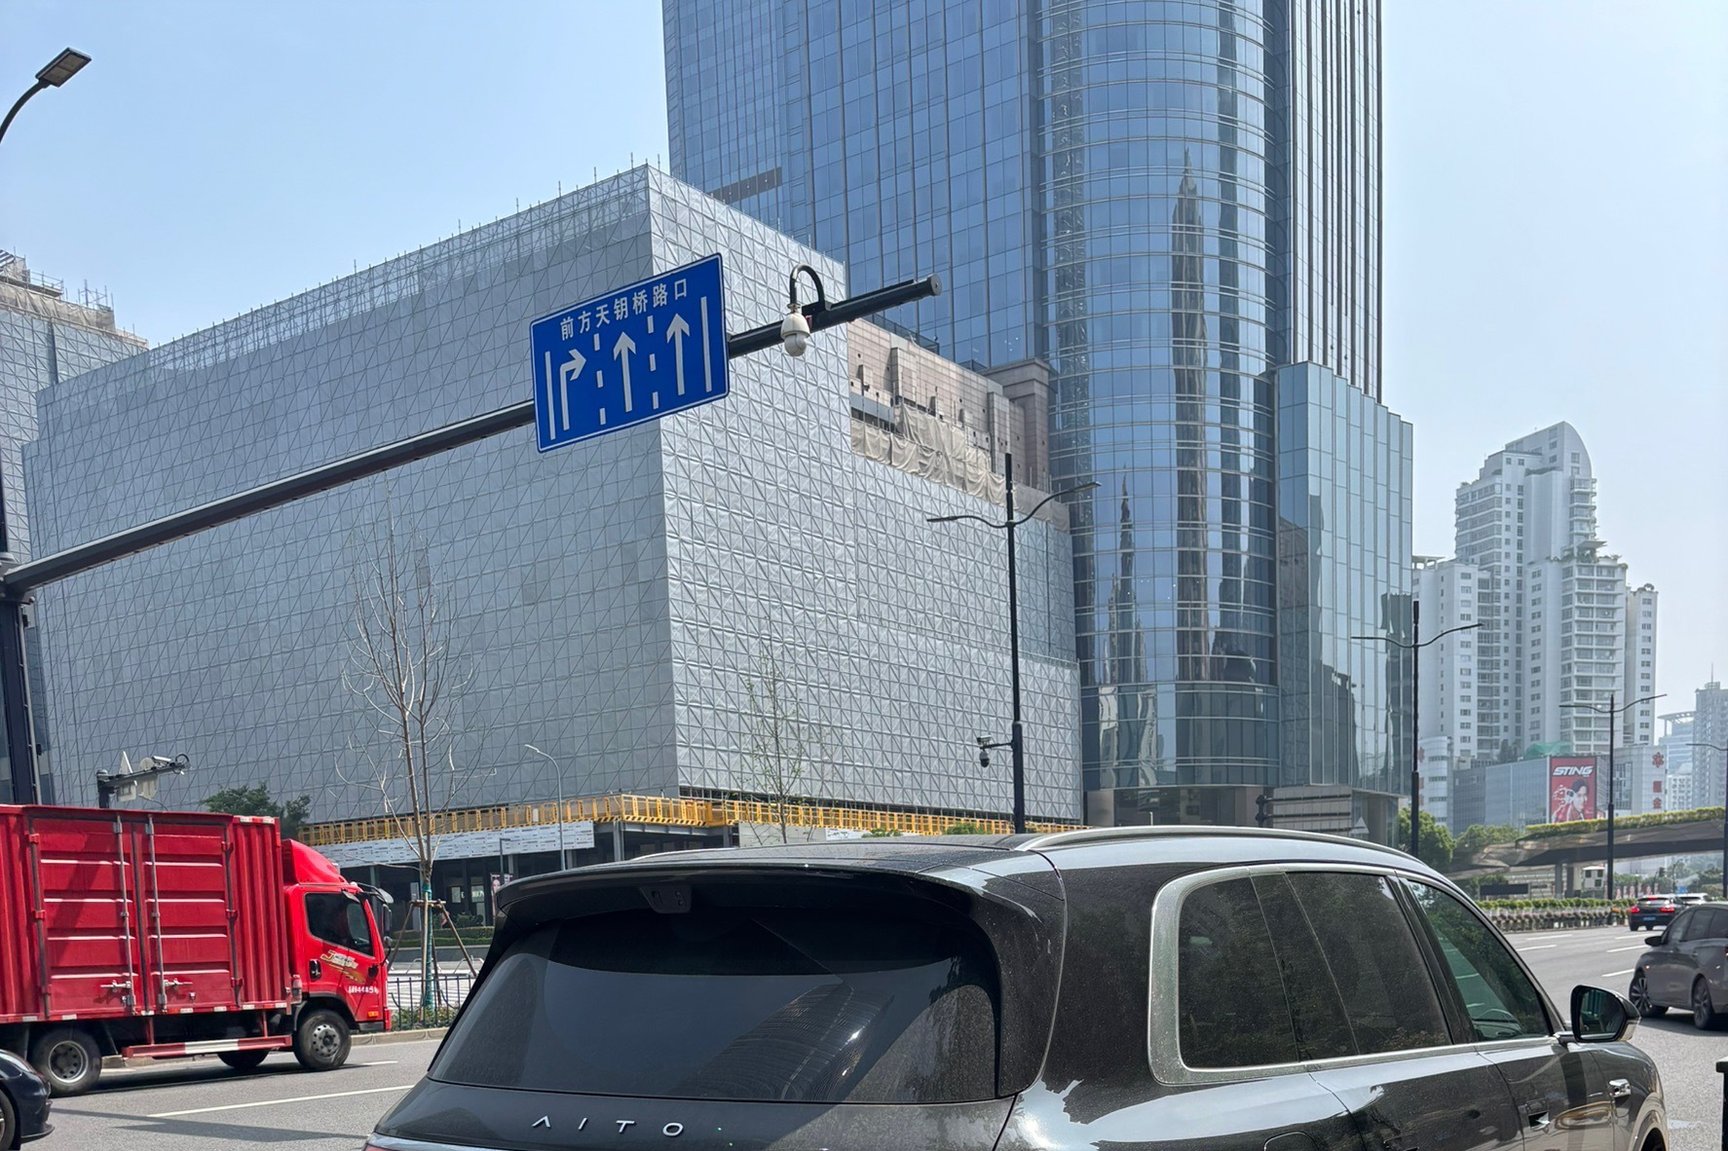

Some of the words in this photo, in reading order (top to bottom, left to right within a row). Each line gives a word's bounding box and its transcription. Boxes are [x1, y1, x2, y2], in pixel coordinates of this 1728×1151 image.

[560, 278, 687, 341] 前方天钥桥路口
[1553, 766, 1594, 776] STING
[531, 1115, 683, 1136] AITO
